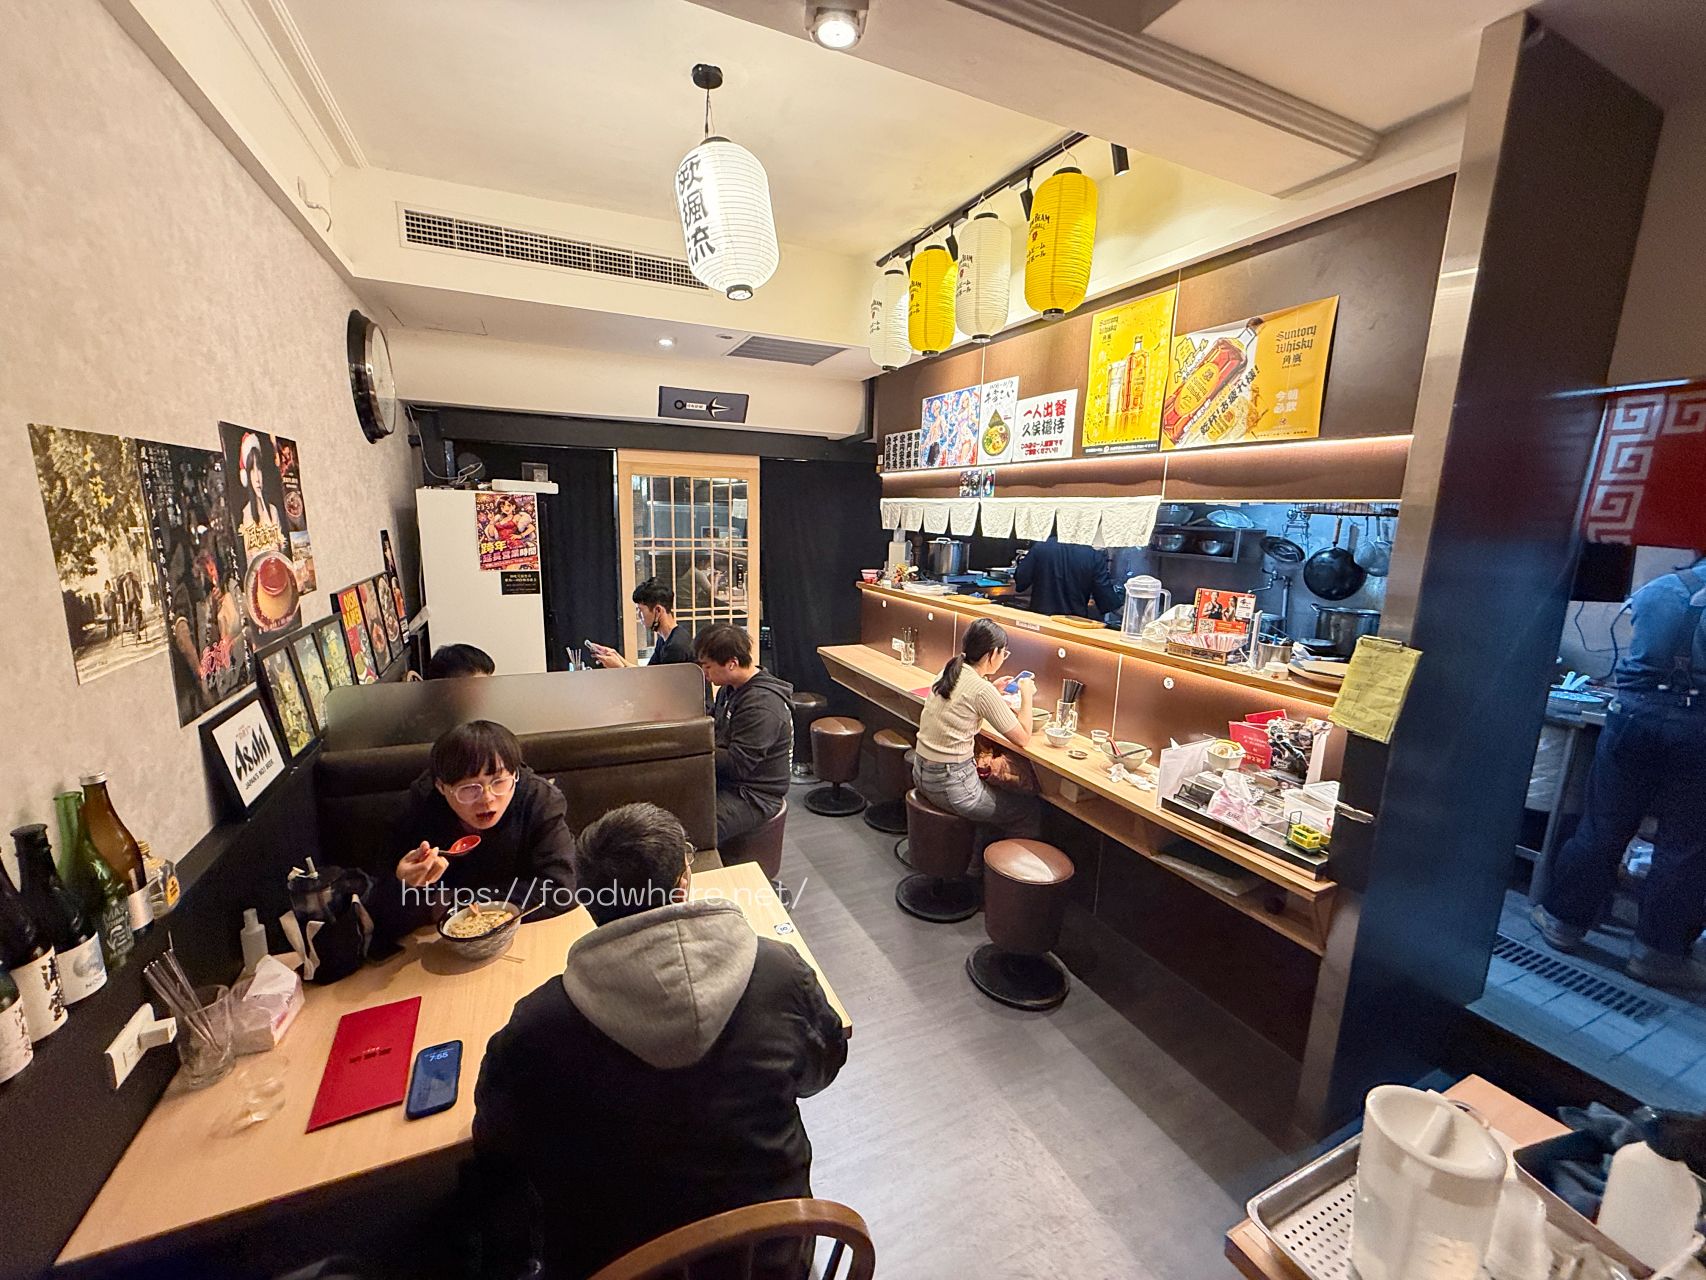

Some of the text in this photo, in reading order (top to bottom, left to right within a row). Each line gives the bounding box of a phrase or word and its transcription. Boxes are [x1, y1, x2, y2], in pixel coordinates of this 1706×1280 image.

[1276, 325, 1317, 342] Suntory
[1276, 338, 1314, 354] Whisky
[1023, 398, 1067, 419] 一人出餐
[235, 722, 271, 782] Asahi
